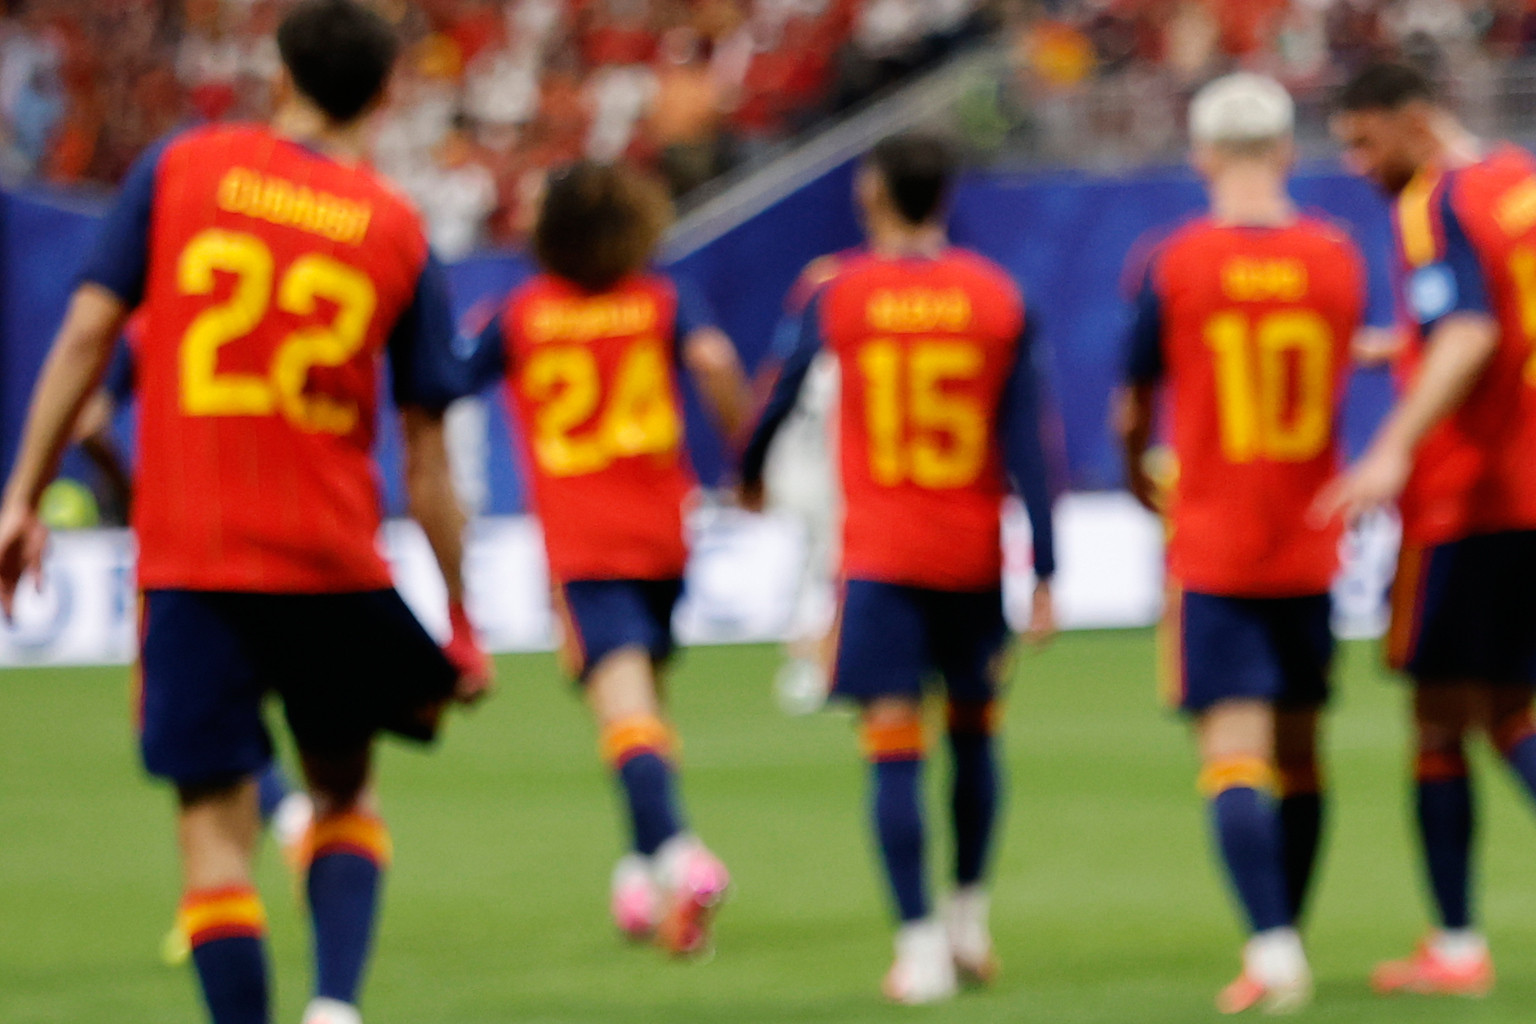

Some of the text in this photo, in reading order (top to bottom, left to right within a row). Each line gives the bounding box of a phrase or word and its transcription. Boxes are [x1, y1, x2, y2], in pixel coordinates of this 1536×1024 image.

[178, 232, 377, 434] 22
[1204, 310, 1334, 464] 10
[525, 343, 684, 477] 24
[859, 337, 986, 488] 15
